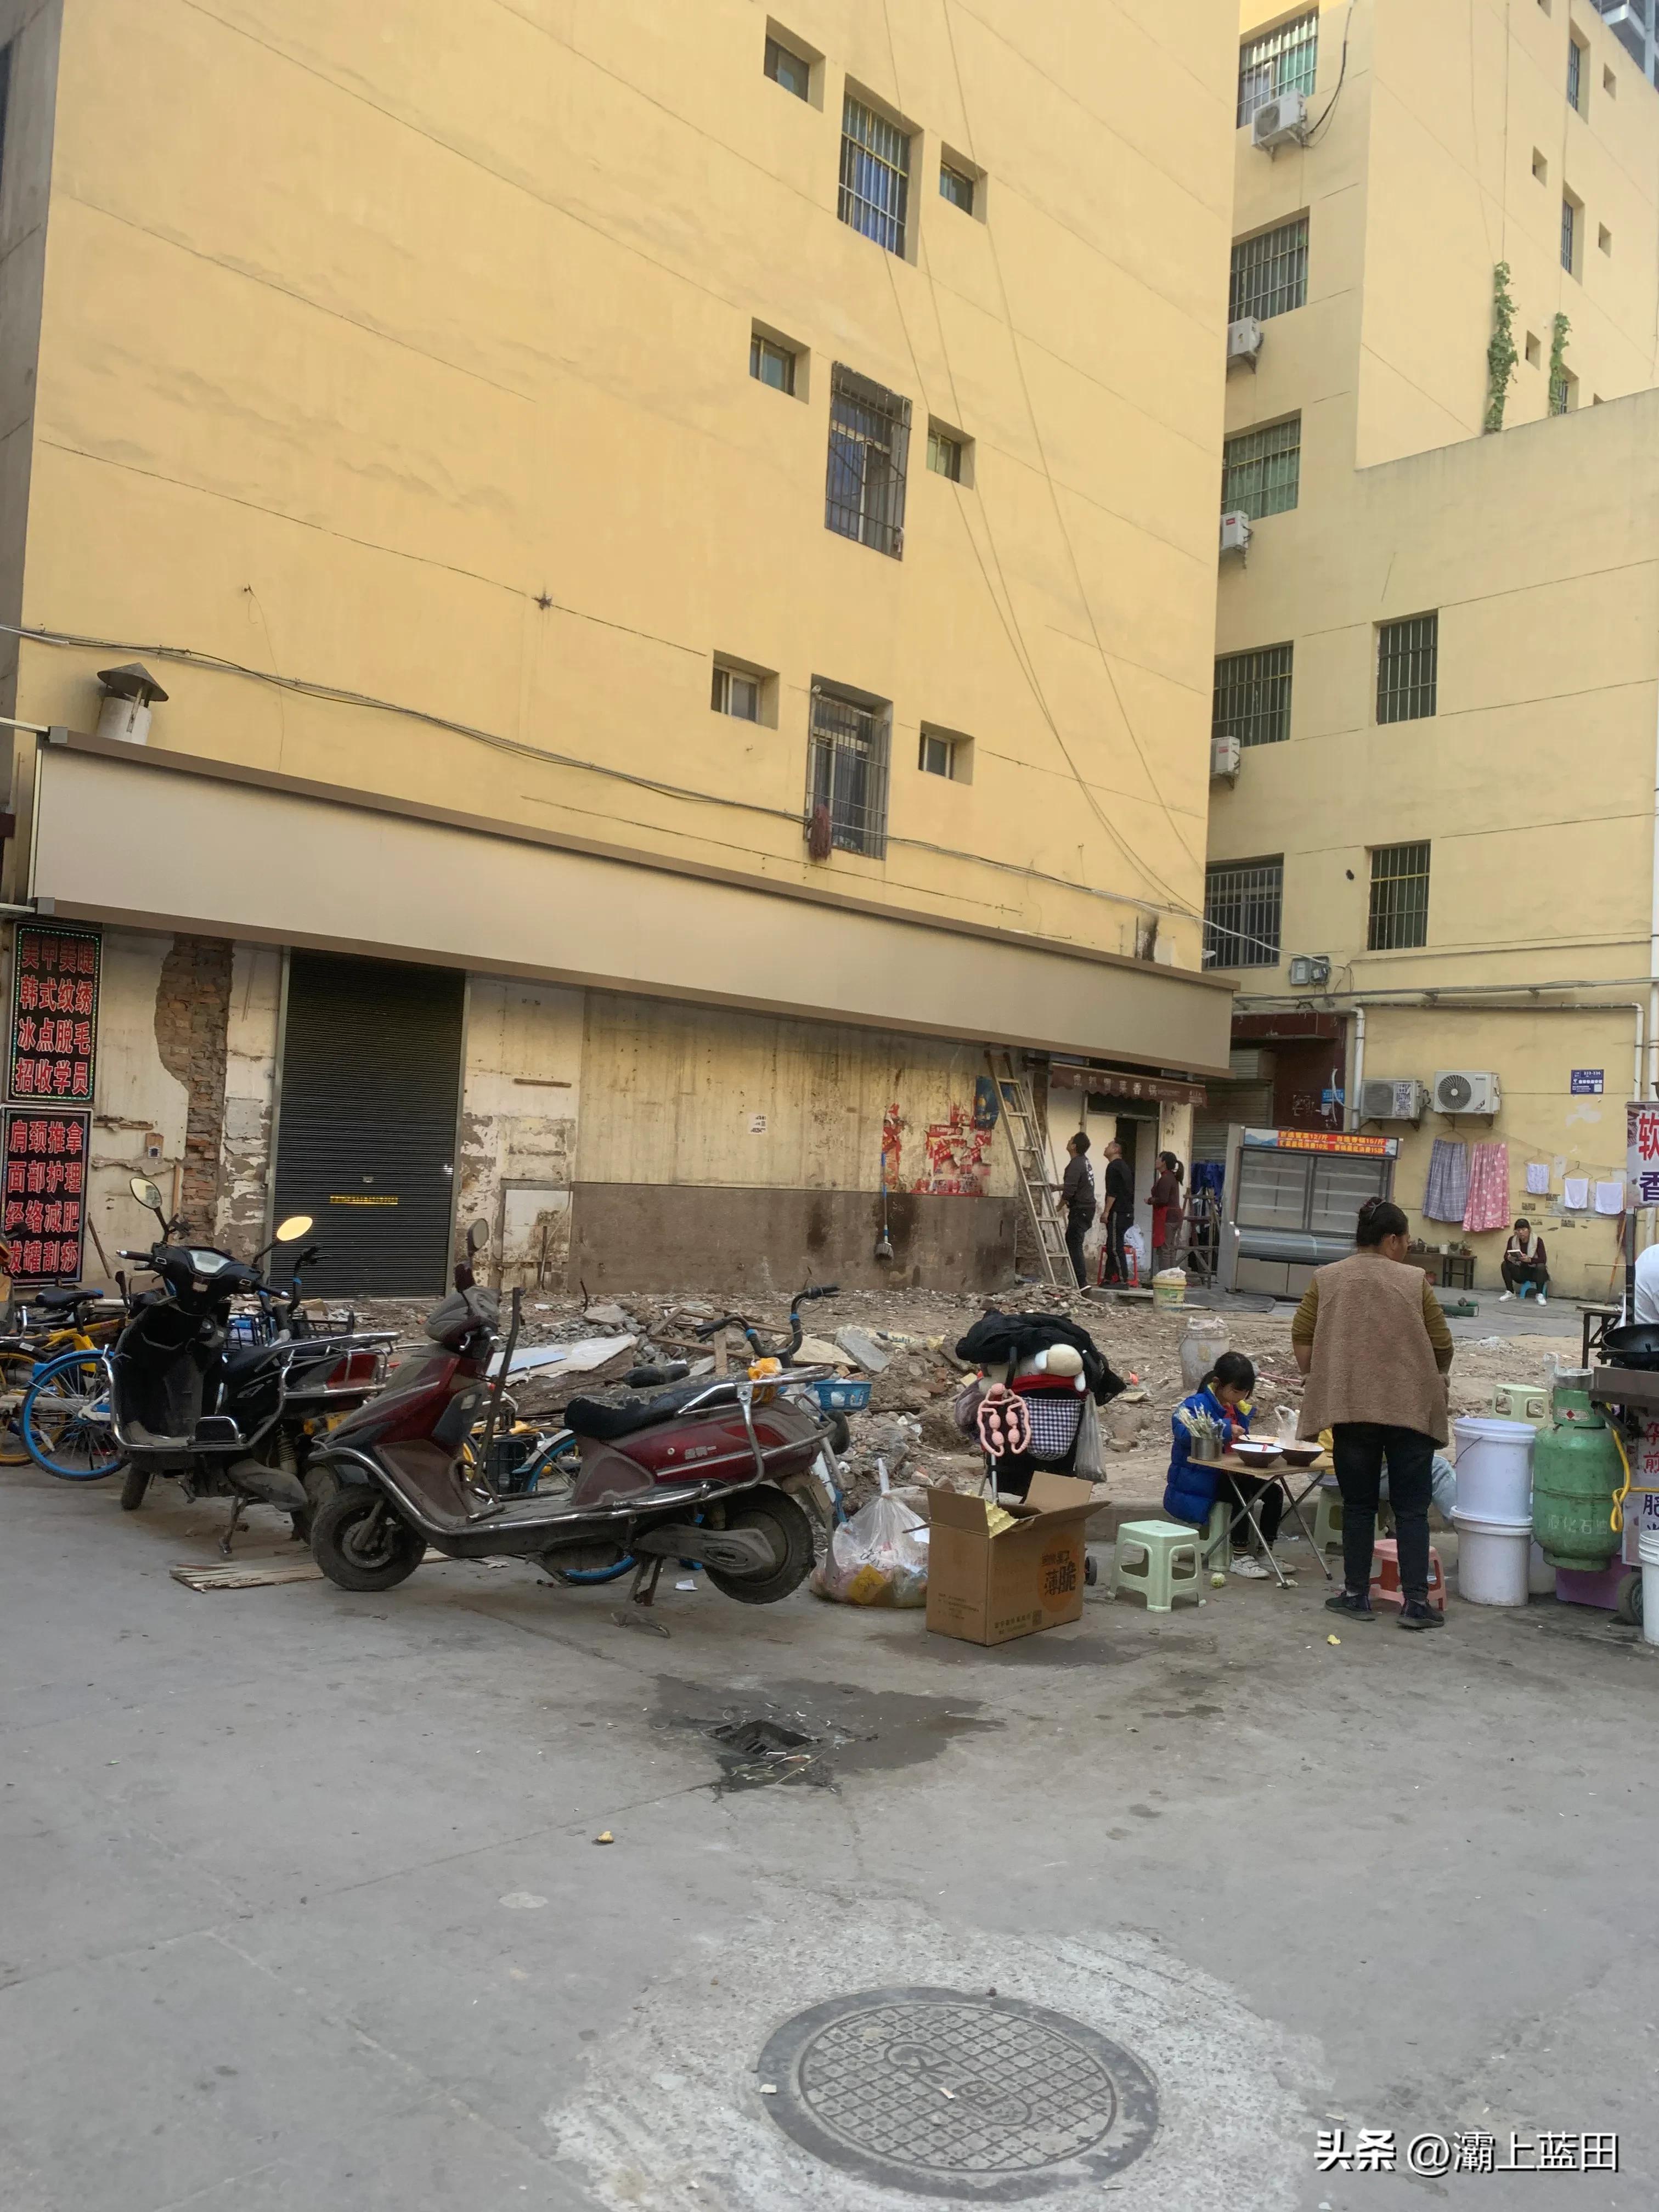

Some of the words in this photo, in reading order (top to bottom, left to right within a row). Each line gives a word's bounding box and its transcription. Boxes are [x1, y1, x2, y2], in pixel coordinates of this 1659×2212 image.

[21, 935, 95, 974] 美甲美睫
[19, 974, 93, 1015] 韩式纹绣
[17, 1017, 91, 1054] 冰点脱毛
[15, 1057, 89, 1095] 招收学员
[9, 1120, 84, 1154] 肩颈推拿
[8, 1160, 82, 1193] 面部护理
[4, 1200, 80, 1233] 经络减肥
